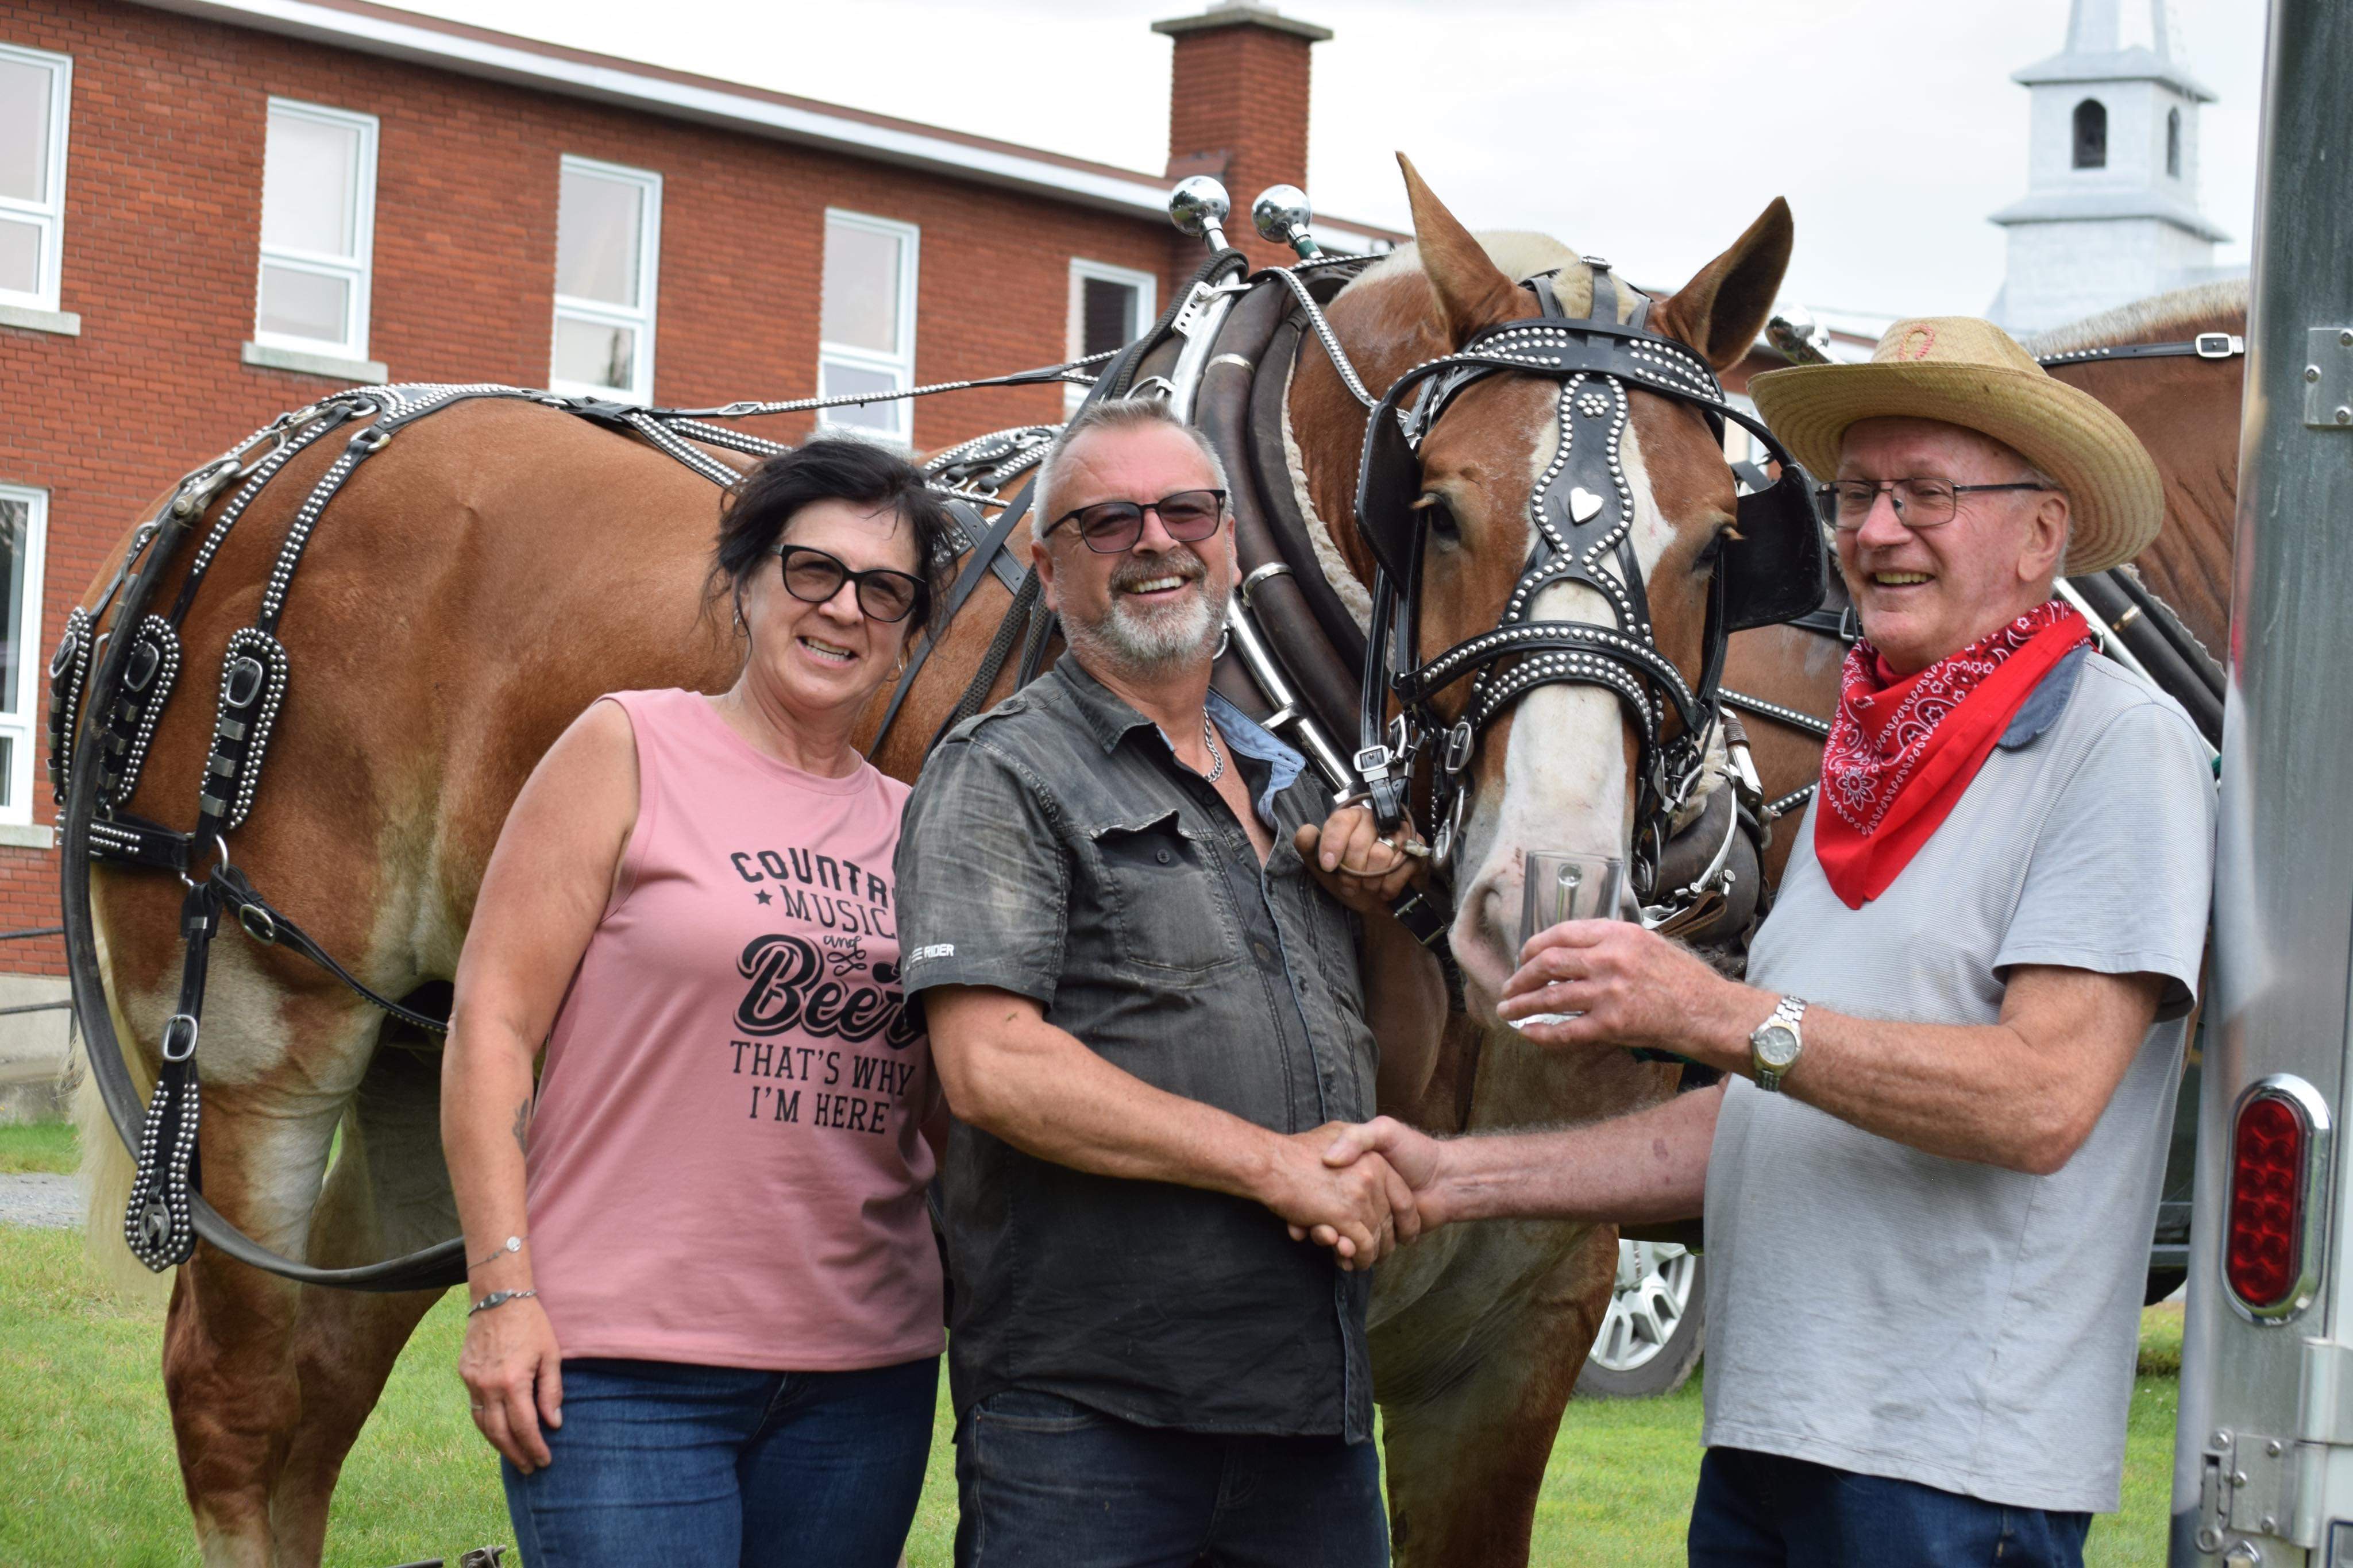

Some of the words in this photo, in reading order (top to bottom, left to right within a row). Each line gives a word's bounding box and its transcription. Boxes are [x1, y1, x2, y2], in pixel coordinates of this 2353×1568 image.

[731, 848, 896, 908] COUNTR
[780, 885, 896, 939] MUSIC
[924, 944, 954, 958] RIDER
[853, 1055, 915, 1096] WHY
[815, 1093, 889, 1134] HERE
